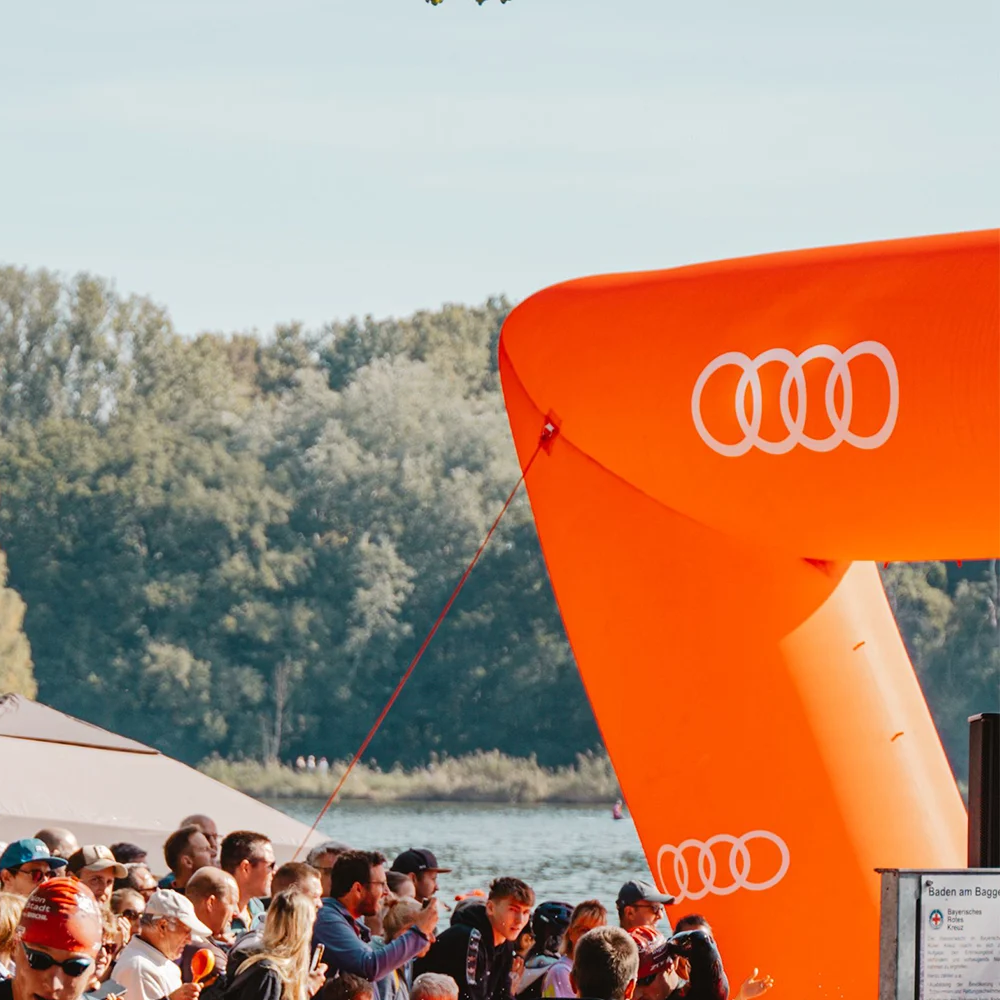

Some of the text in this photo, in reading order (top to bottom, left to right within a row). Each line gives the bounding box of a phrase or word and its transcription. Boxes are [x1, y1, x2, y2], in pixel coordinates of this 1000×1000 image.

[928, 886, 956, 897] Baden
[959, 889, 972, 897] am
[947, 908, 982, 917] Bayerisches
